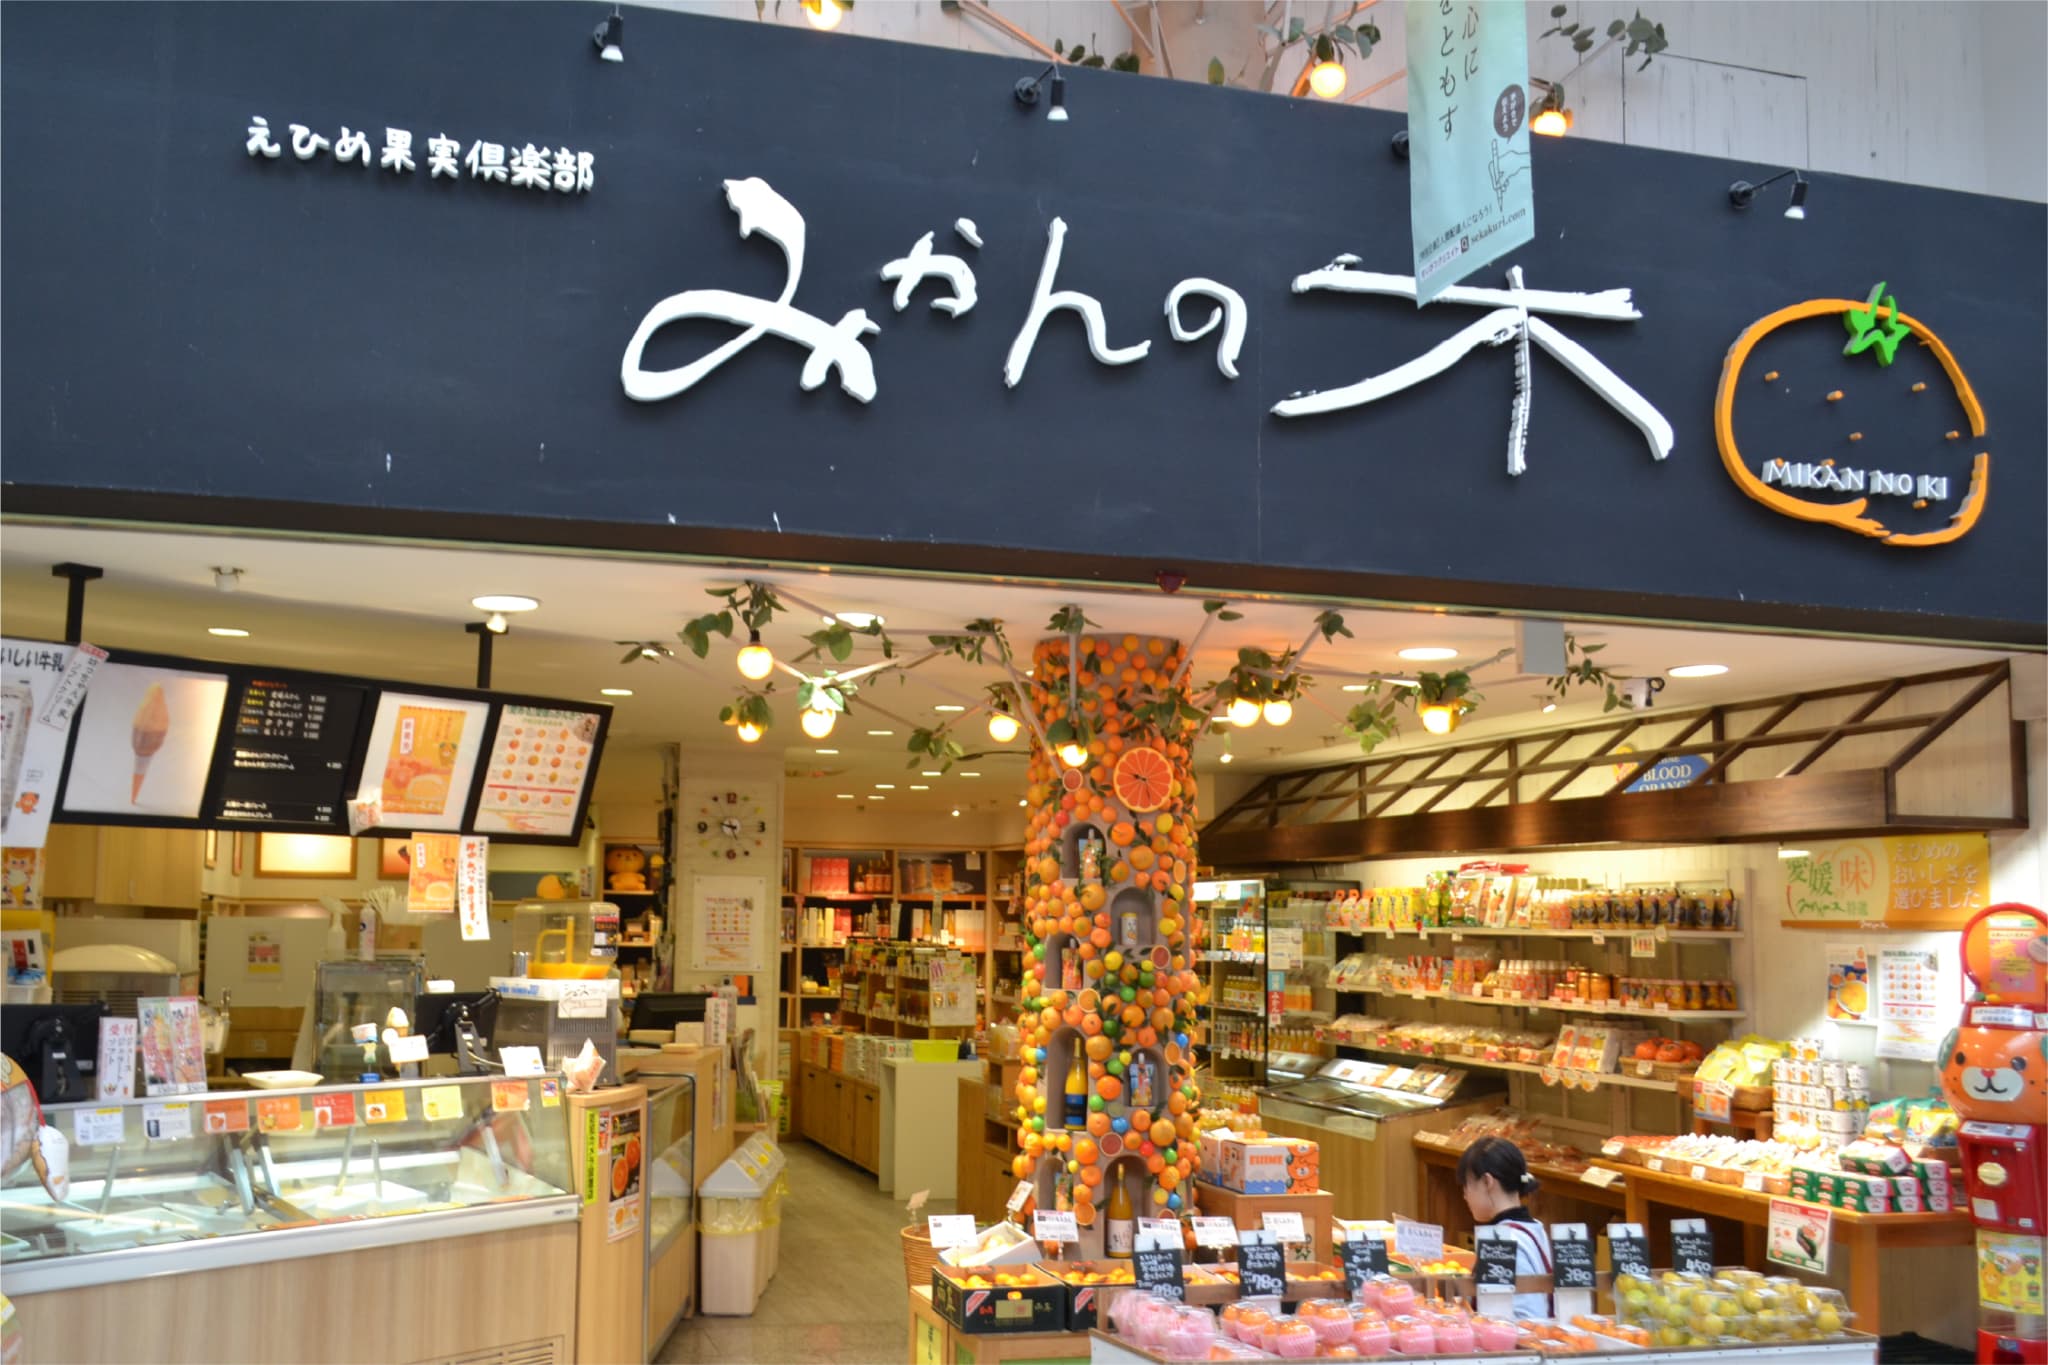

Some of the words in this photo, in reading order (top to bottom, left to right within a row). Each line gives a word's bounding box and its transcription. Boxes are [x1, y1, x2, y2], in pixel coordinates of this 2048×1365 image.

[246, 115, 595, 194] えひめ果実倶楽部
[620, 176, 1676, 475] みかんの木
[1762, 459, 1866, 492] MIKAN
[1868, 469, 1913, 496] NO
[1916, 475, 1949, 500] KI
[1643, 764, 1693, 782] BLOOD
[757, 821, 766, 833] 3
[1893, 887, 1982, 910] 選びました
[1488, 1262, 1514, 1279] 380
[1564, 1266, 1592, 1282] 380
[1621, 1262, 1649, 1275] 480
